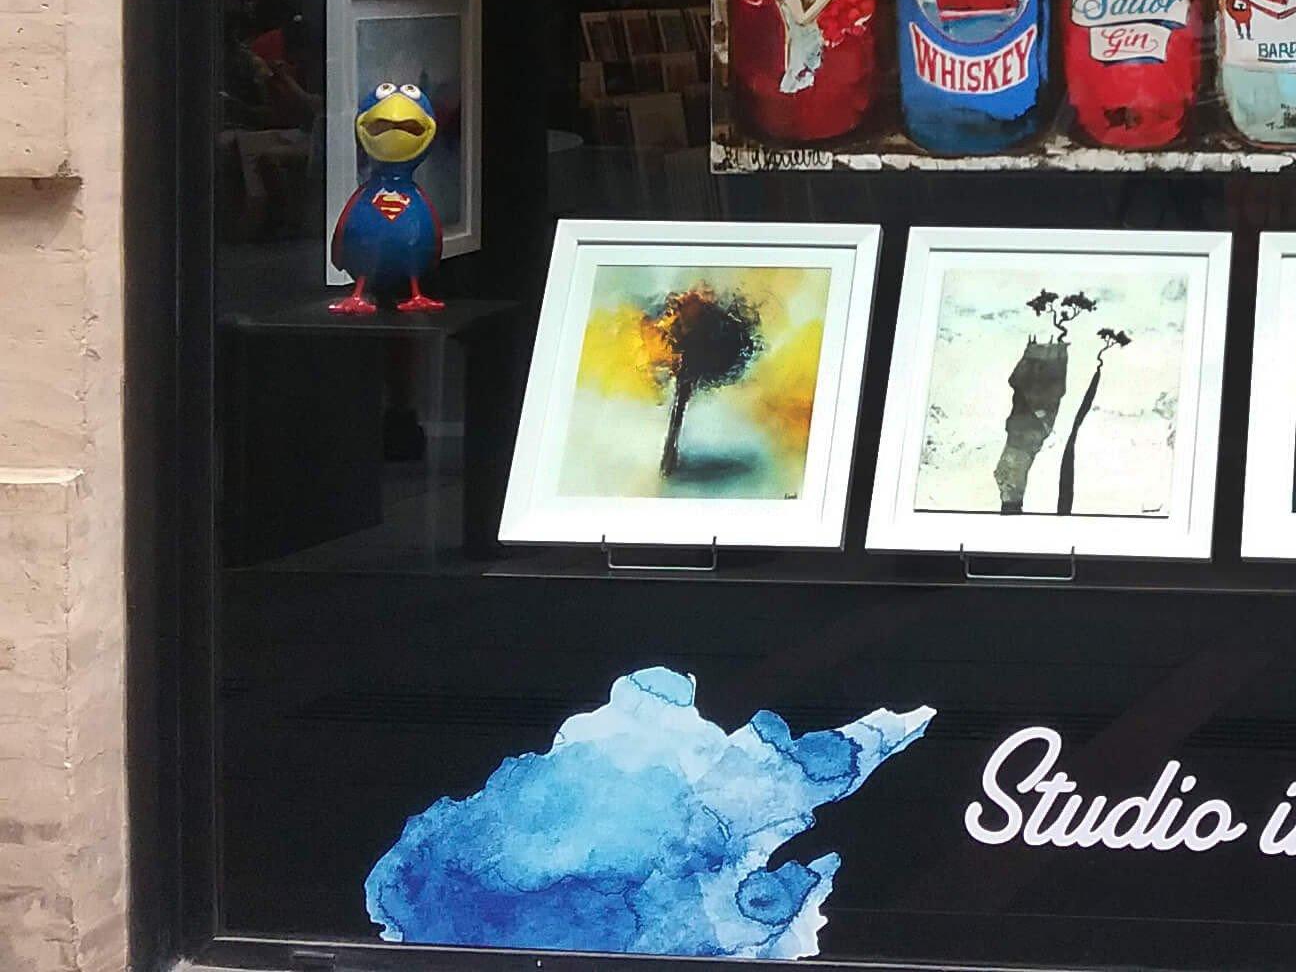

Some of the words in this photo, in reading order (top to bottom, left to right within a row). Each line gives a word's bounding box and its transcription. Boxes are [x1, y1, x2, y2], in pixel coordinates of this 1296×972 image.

[911, 34, 1033, 91] WHISKEY
[1101, 28, 1159, 58] Gin
[964, 726, 1246, 852] Studio
